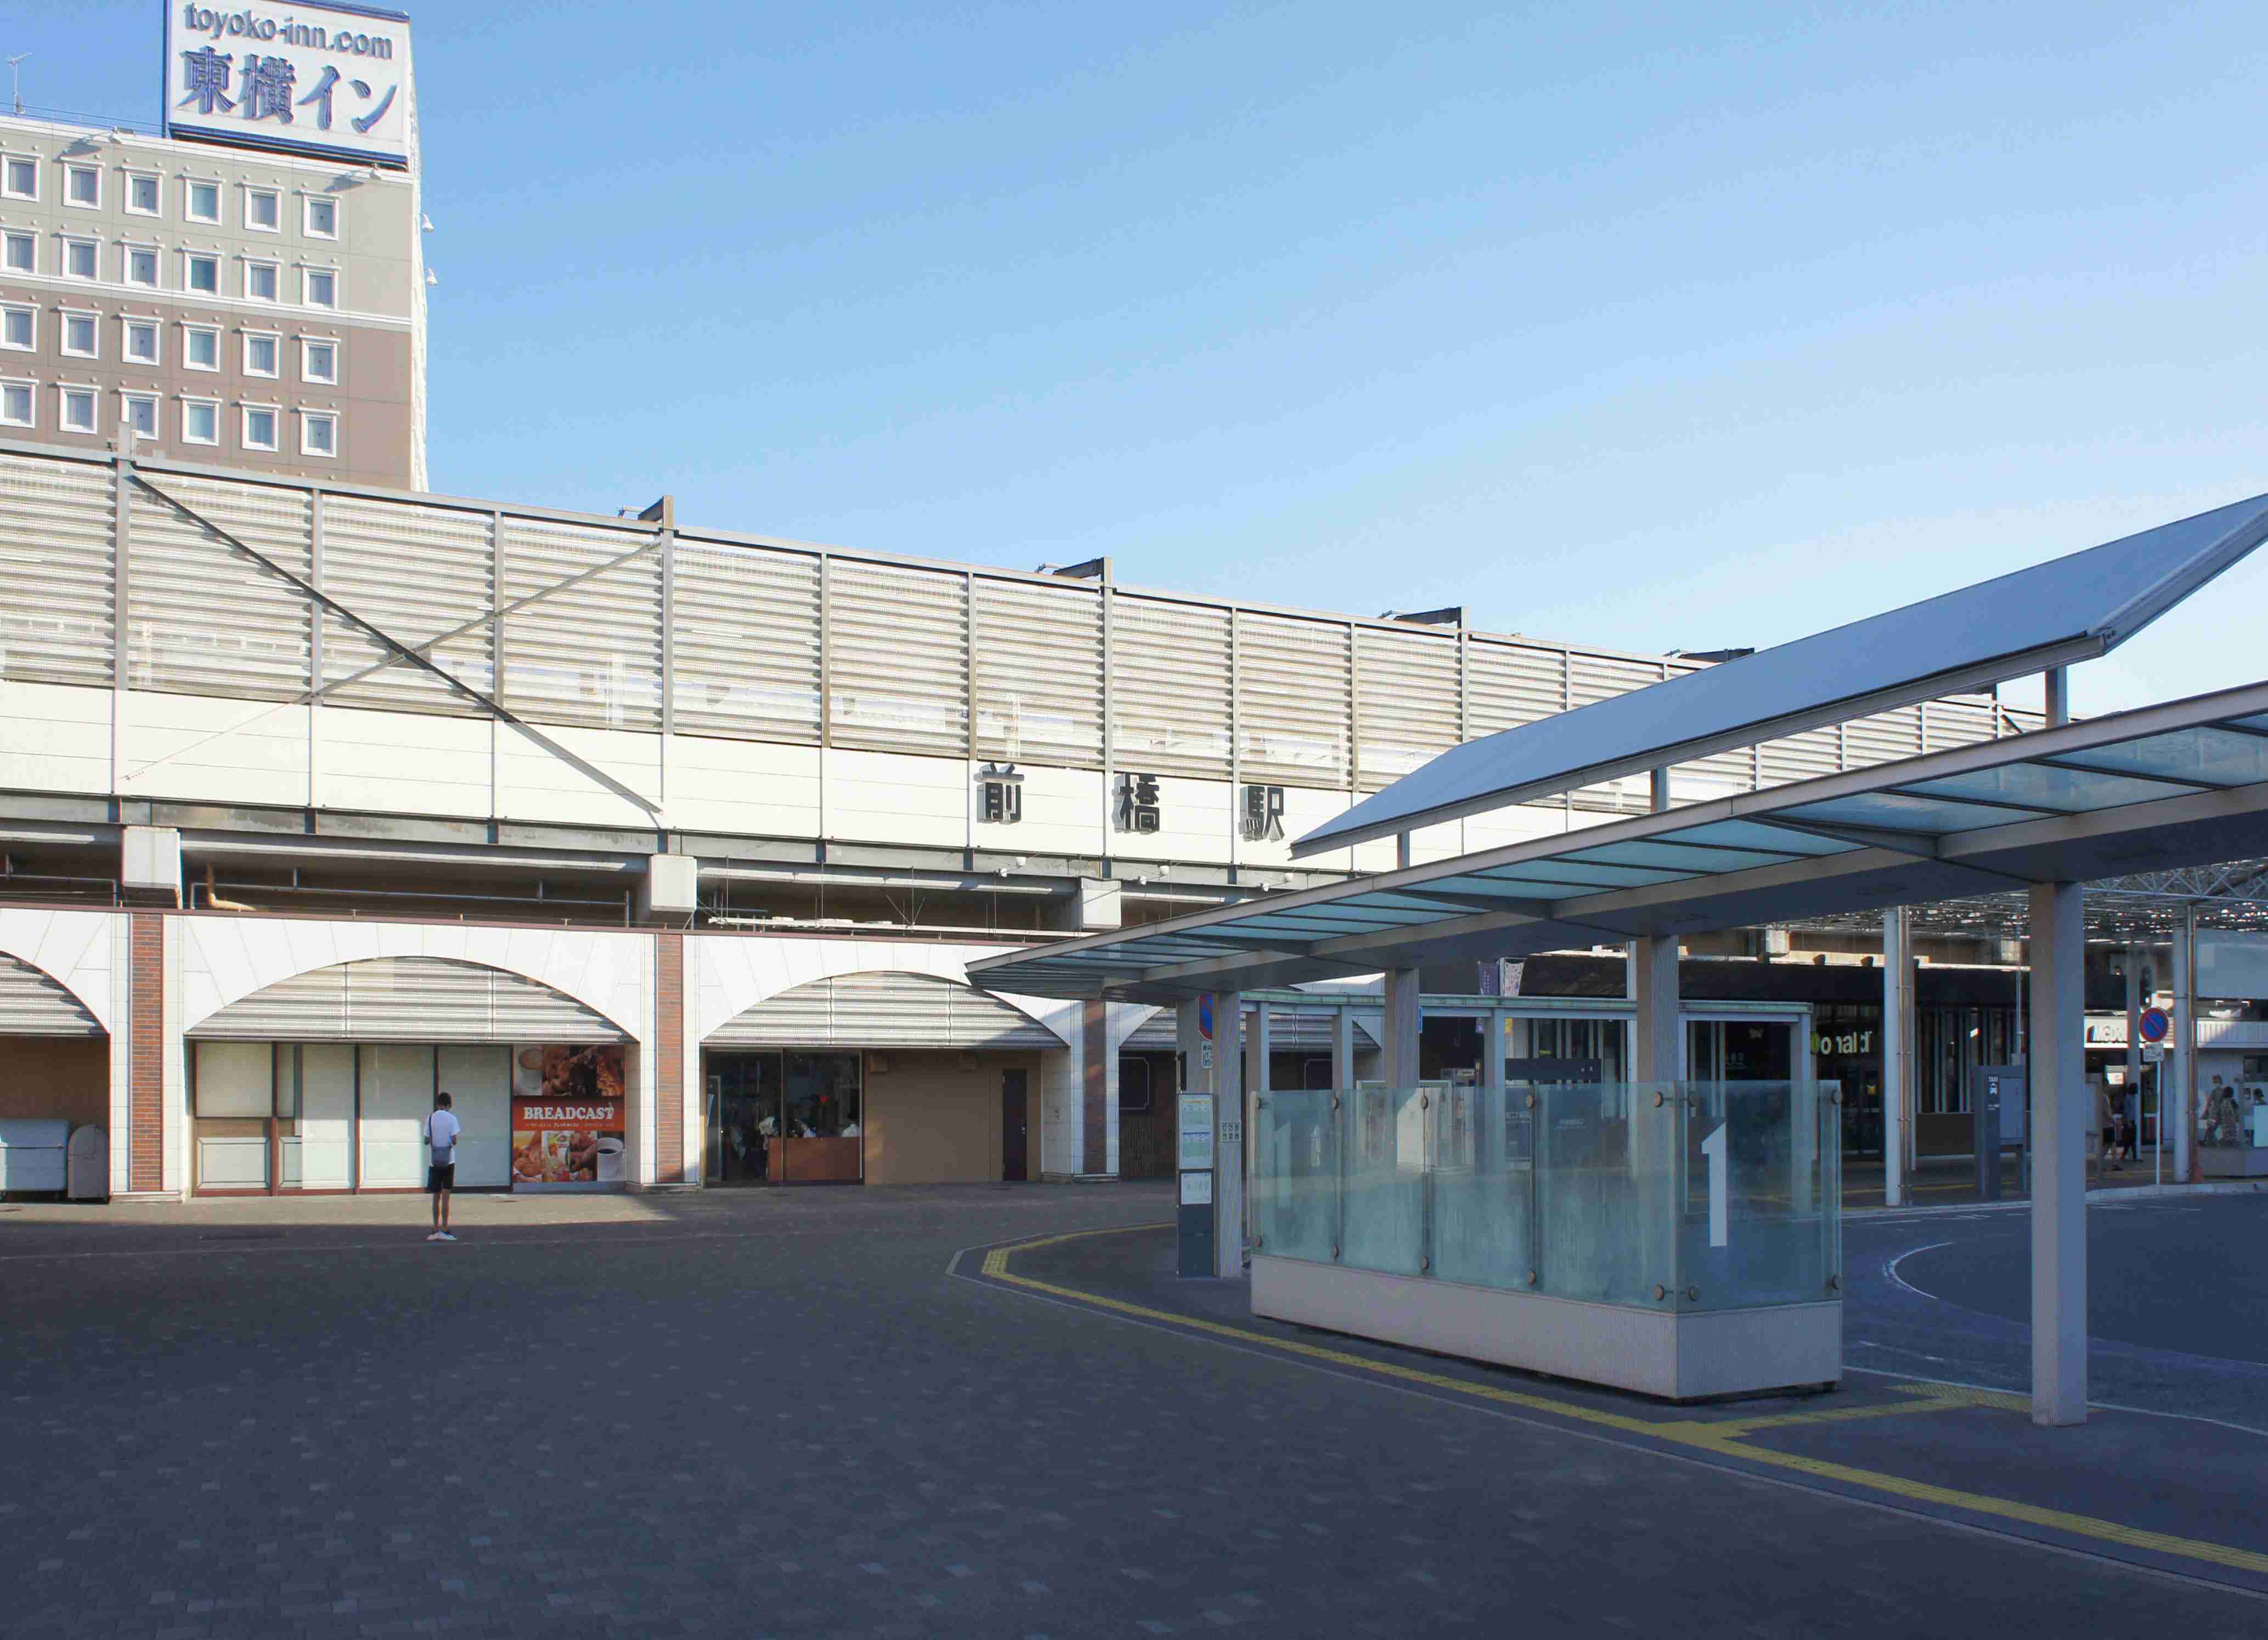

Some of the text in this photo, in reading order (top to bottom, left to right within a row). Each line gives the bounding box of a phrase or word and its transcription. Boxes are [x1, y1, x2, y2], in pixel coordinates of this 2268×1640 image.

[184, 2, 393, 59] toyoko-inn.com
[176, 46, 398, 134] 東横イン
[974, 762, 1285, 842] 前橋駅
[523, 1105, 615, 1120] BREADCAST
[1701, 1122, 1727, 1247] 1
